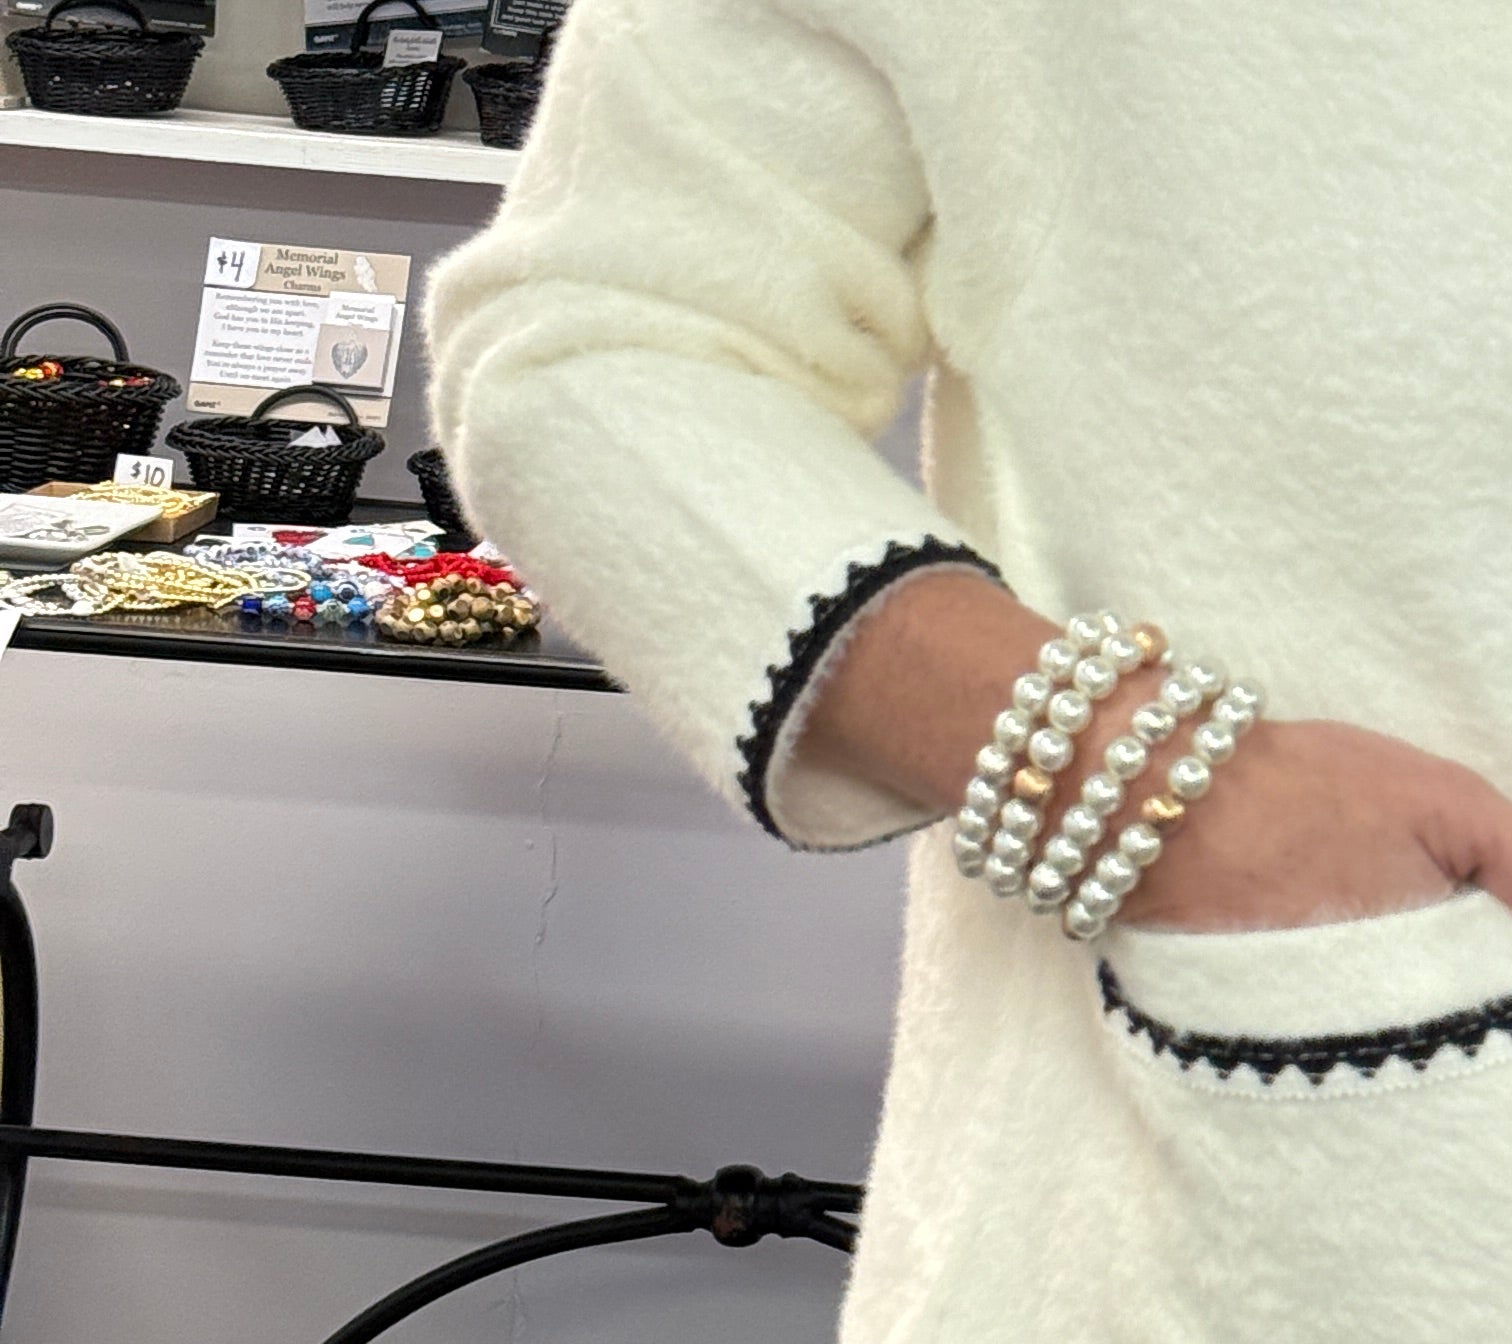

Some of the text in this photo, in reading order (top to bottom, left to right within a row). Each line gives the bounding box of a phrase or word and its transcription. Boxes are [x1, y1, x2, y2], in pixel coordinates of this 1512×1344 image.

[216, 250, 246, 283] $4
[277, 248, 339, 266] Memorial
[264, 263, 347, 282] Angel Wings
[283, 280, 322, 293] Charms
[130, 460, 166, 487] $10
